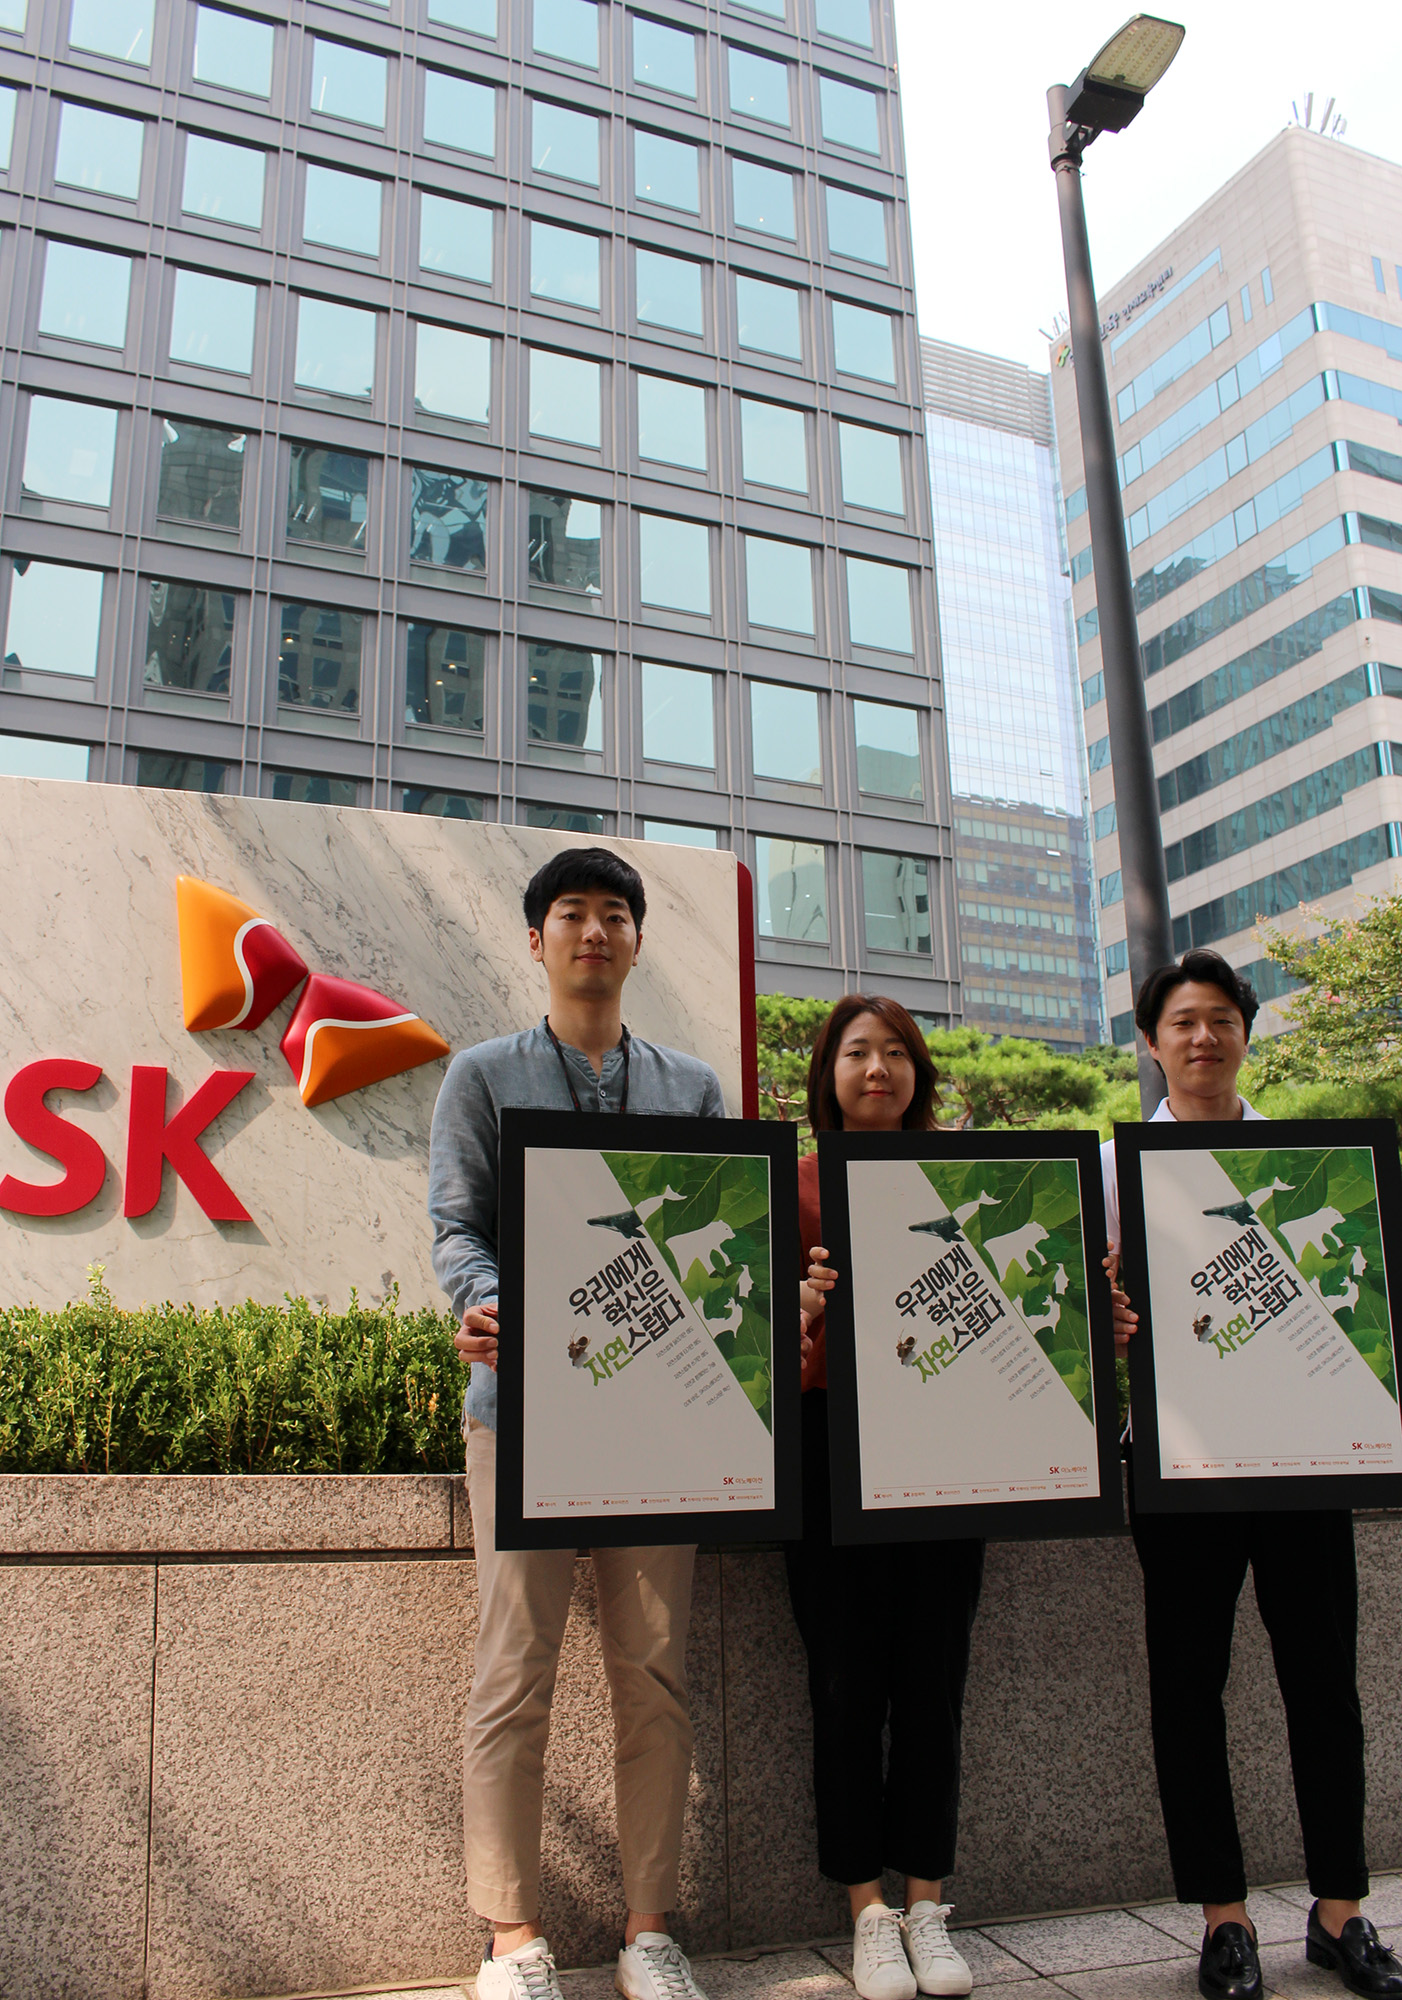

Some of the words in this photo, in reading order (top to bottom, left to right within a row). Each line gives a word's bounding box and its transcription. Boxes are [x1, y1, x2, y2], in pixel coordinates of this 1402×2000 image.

[0, 1059, 256, 1222] SK
[569, 1239, 653, 1316] 우리에게
[895, 1243, 972, 1317] 우리에게
[1191, 1226, 1267, 1296] 우리에게
[1222, 1252, 1284, 1305] 혁신은
[601, 1269, 668, 1326] 혁신은
[926, 1270, 988, 1326] 혁신은
[1049, 1466, 1059, 1474] SK
